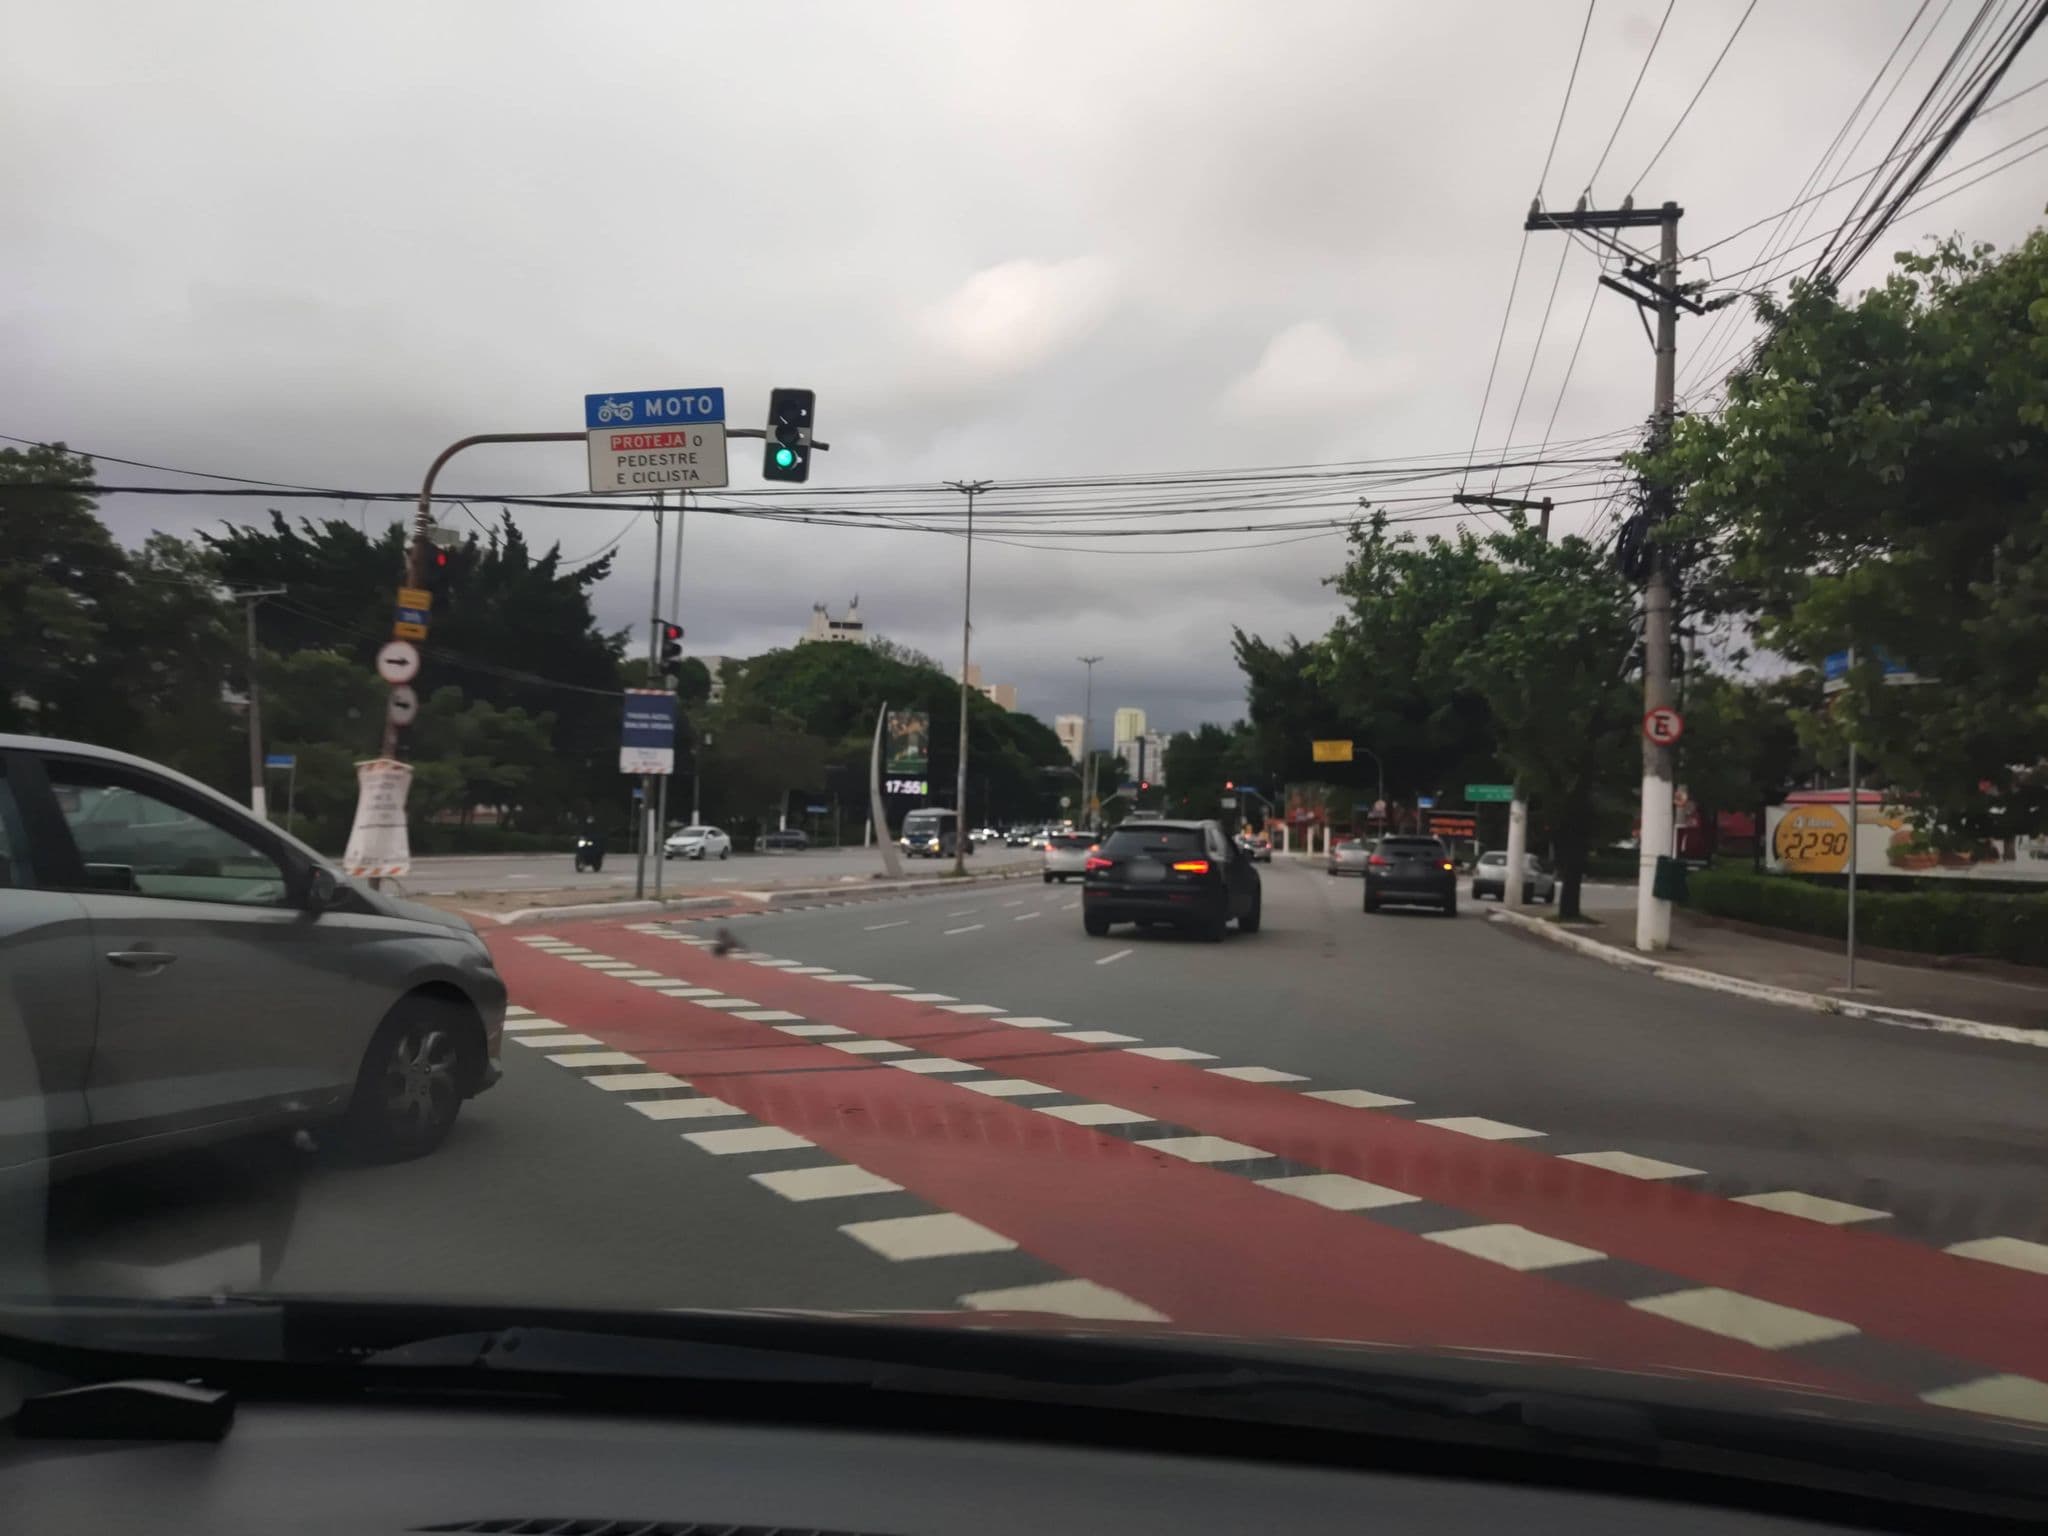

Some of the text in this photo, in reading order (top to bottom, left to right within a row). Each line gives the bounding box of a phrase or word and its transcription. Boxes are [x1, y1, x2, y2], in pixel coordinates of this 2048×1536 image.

[645, 396, 712, 416] MOTO
[612, 434, 684, 448] PROTEJA
[617, 452, 697, 467] PEDESTRE
[617, 470, 700, 485] E CICLISTA
